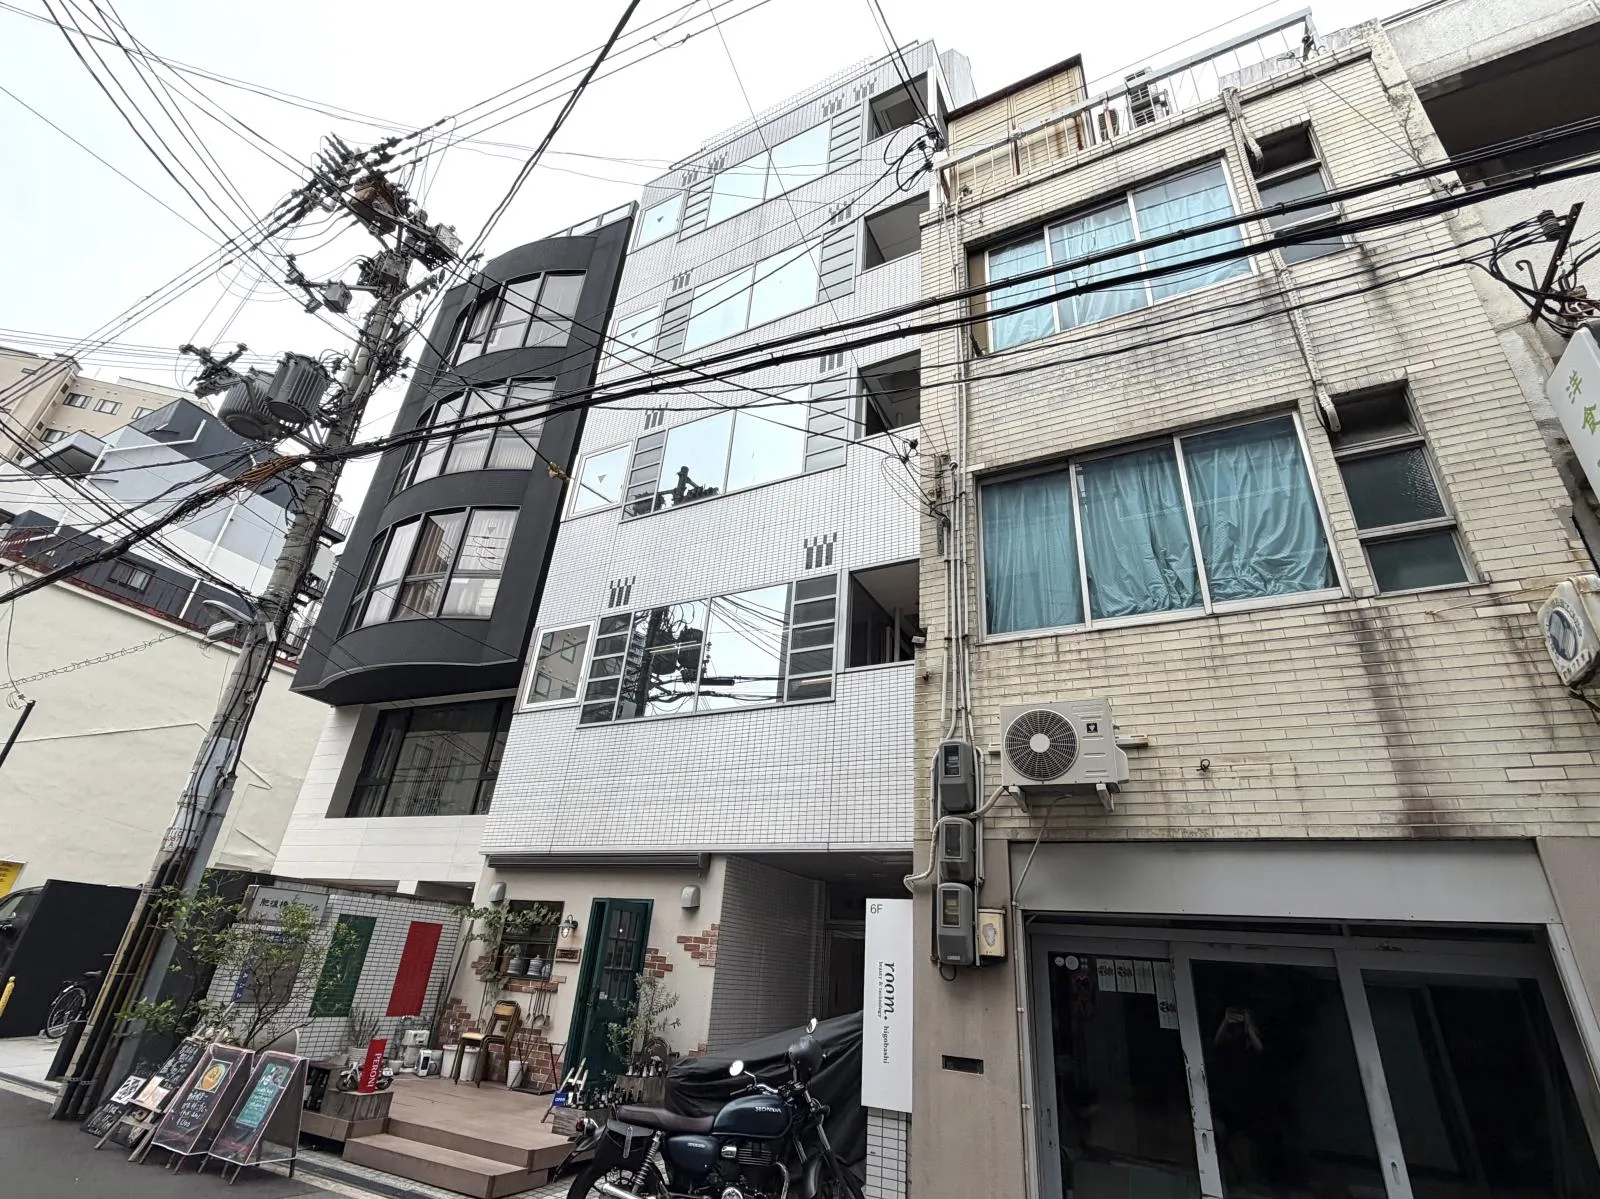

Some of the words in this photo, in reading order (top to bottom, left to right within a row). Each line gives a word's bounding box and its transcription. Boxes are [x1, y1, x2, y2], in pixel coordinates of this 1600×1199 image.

[870, 903, 883, 914] 6F
[884, 961, 895, 1020] room.
[367, 1053, 382, 1087] PERONI
